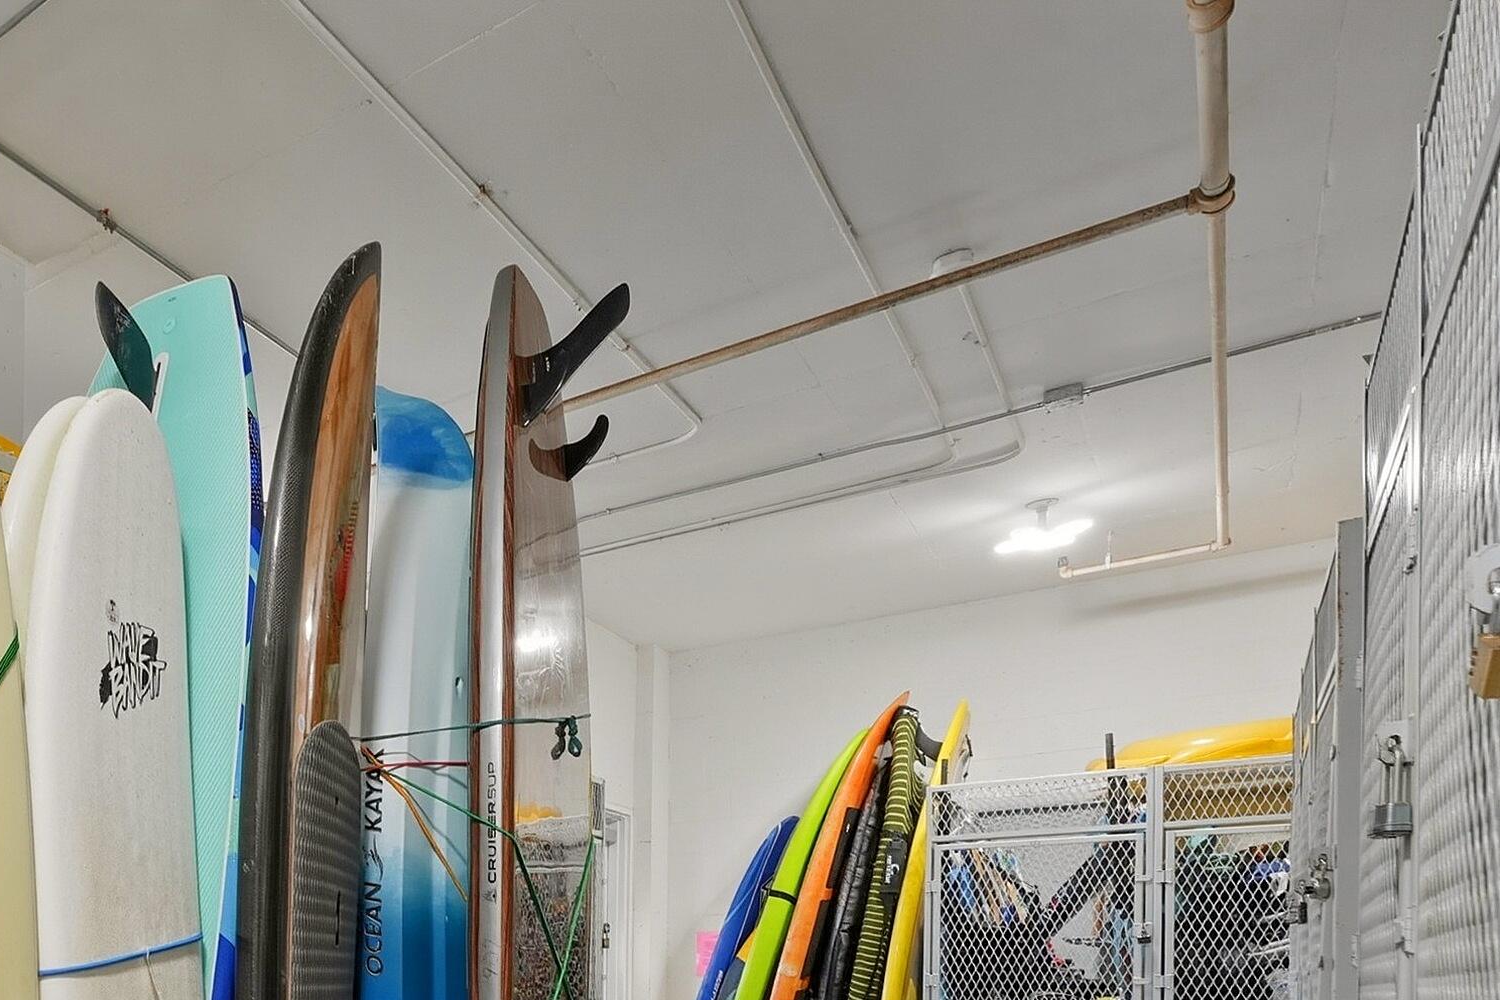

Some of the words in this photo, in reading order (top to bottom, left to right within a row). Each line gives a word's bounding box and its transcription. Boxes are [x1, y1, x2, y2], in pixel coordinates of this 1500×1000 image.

[108, 622, 156, 668] WAVE
[109, 659, 168, 719] BANDIT
[364, 882, 383, 977] OCEAN
